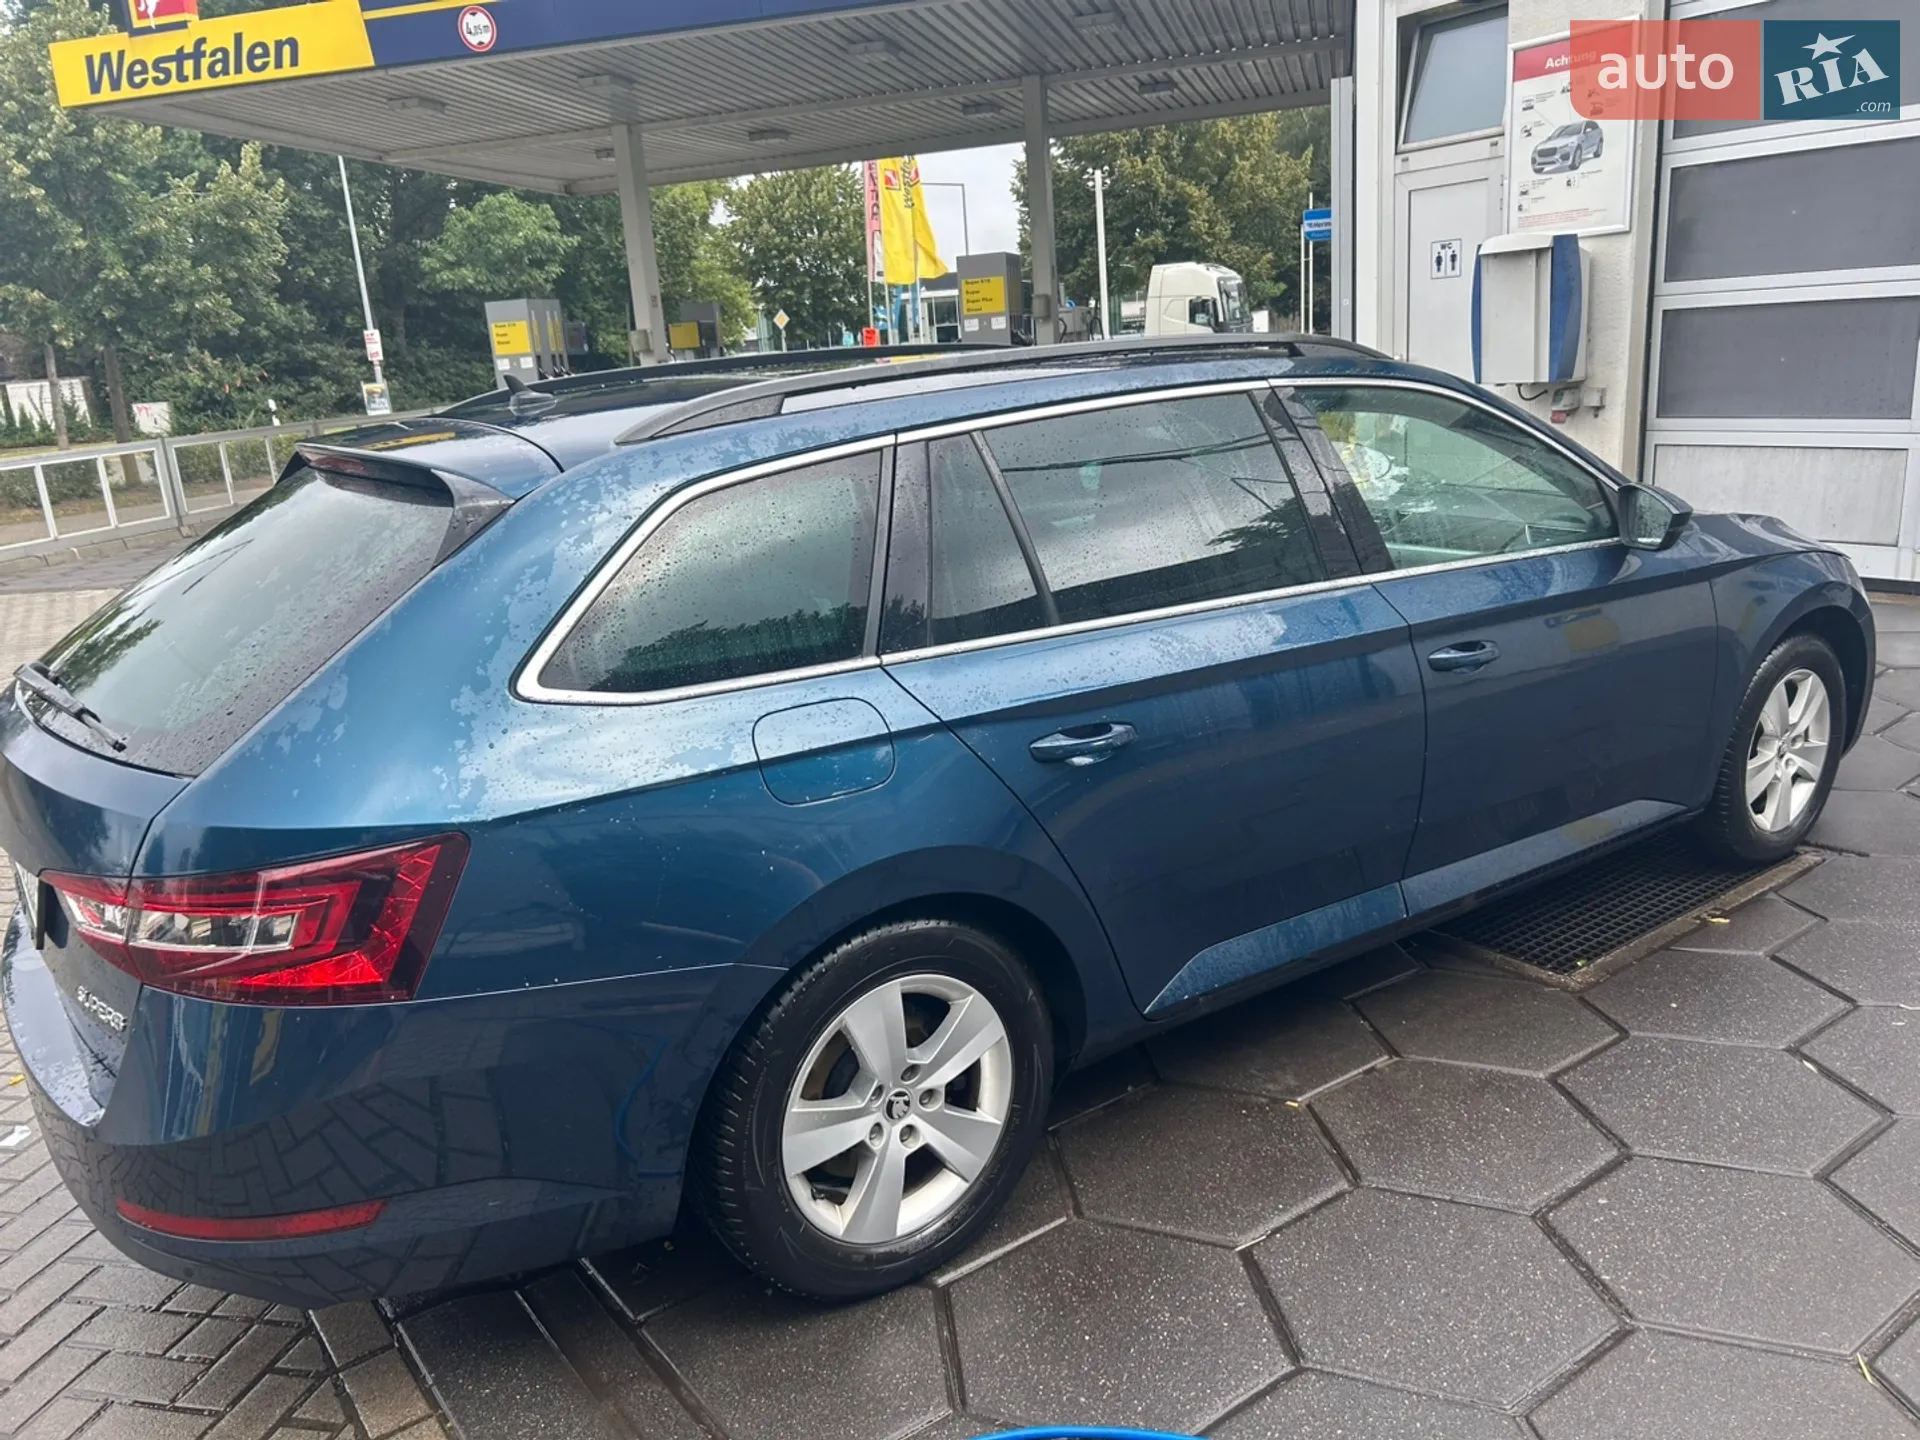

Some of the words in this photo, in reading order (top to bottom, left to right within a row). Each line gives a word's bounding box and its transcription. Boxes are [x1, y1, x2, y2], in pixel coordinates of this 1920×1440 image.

[84, 31, 299, 96] Westfalen
[1544, 51, 1598, 69] Achtung
[1440, 242, 1453, 250] WC
